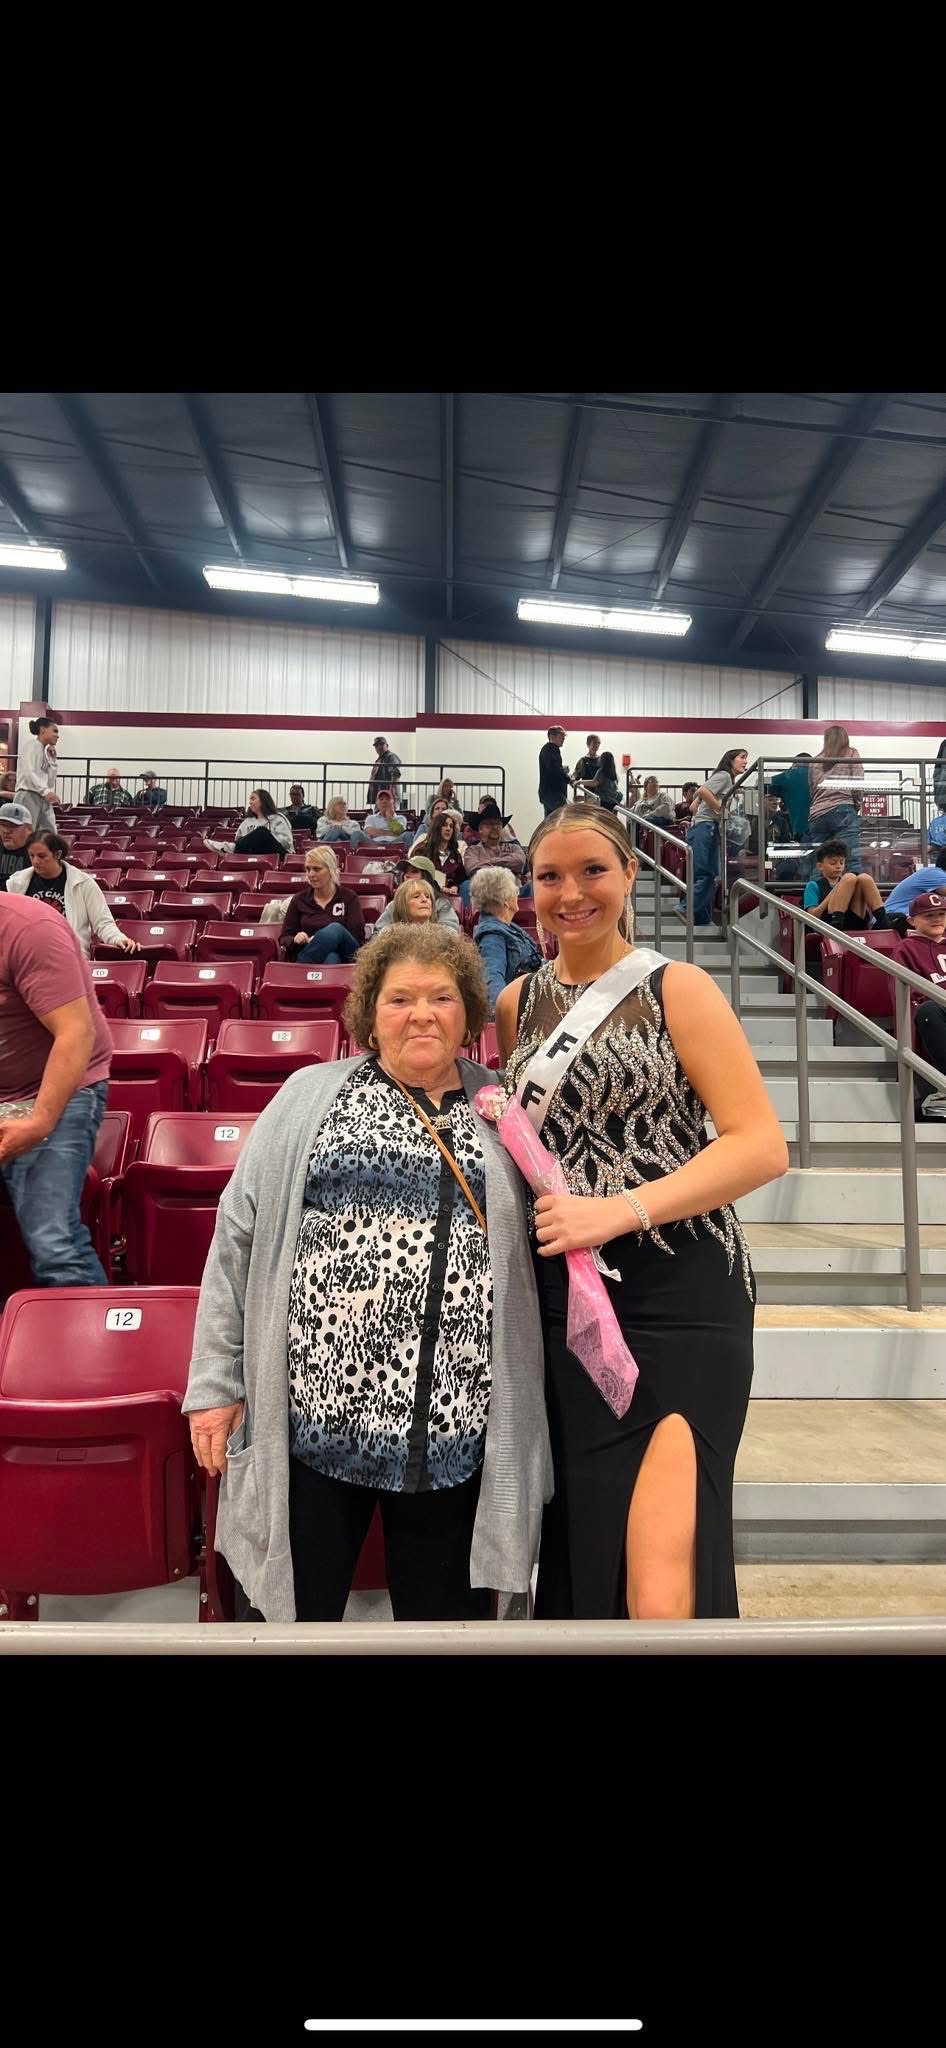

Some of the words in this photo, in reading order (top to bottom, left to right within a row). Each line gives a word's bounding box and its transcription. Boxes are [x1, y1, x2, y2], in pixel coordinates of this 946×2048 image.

[929, 894, 942, 906] C
[96, 968, 105, 976] 10
[277, 1032, 288, 1040] 12
[219, 1129, 234, 1138] 12
[114, 1311, 133, 1326] 12
